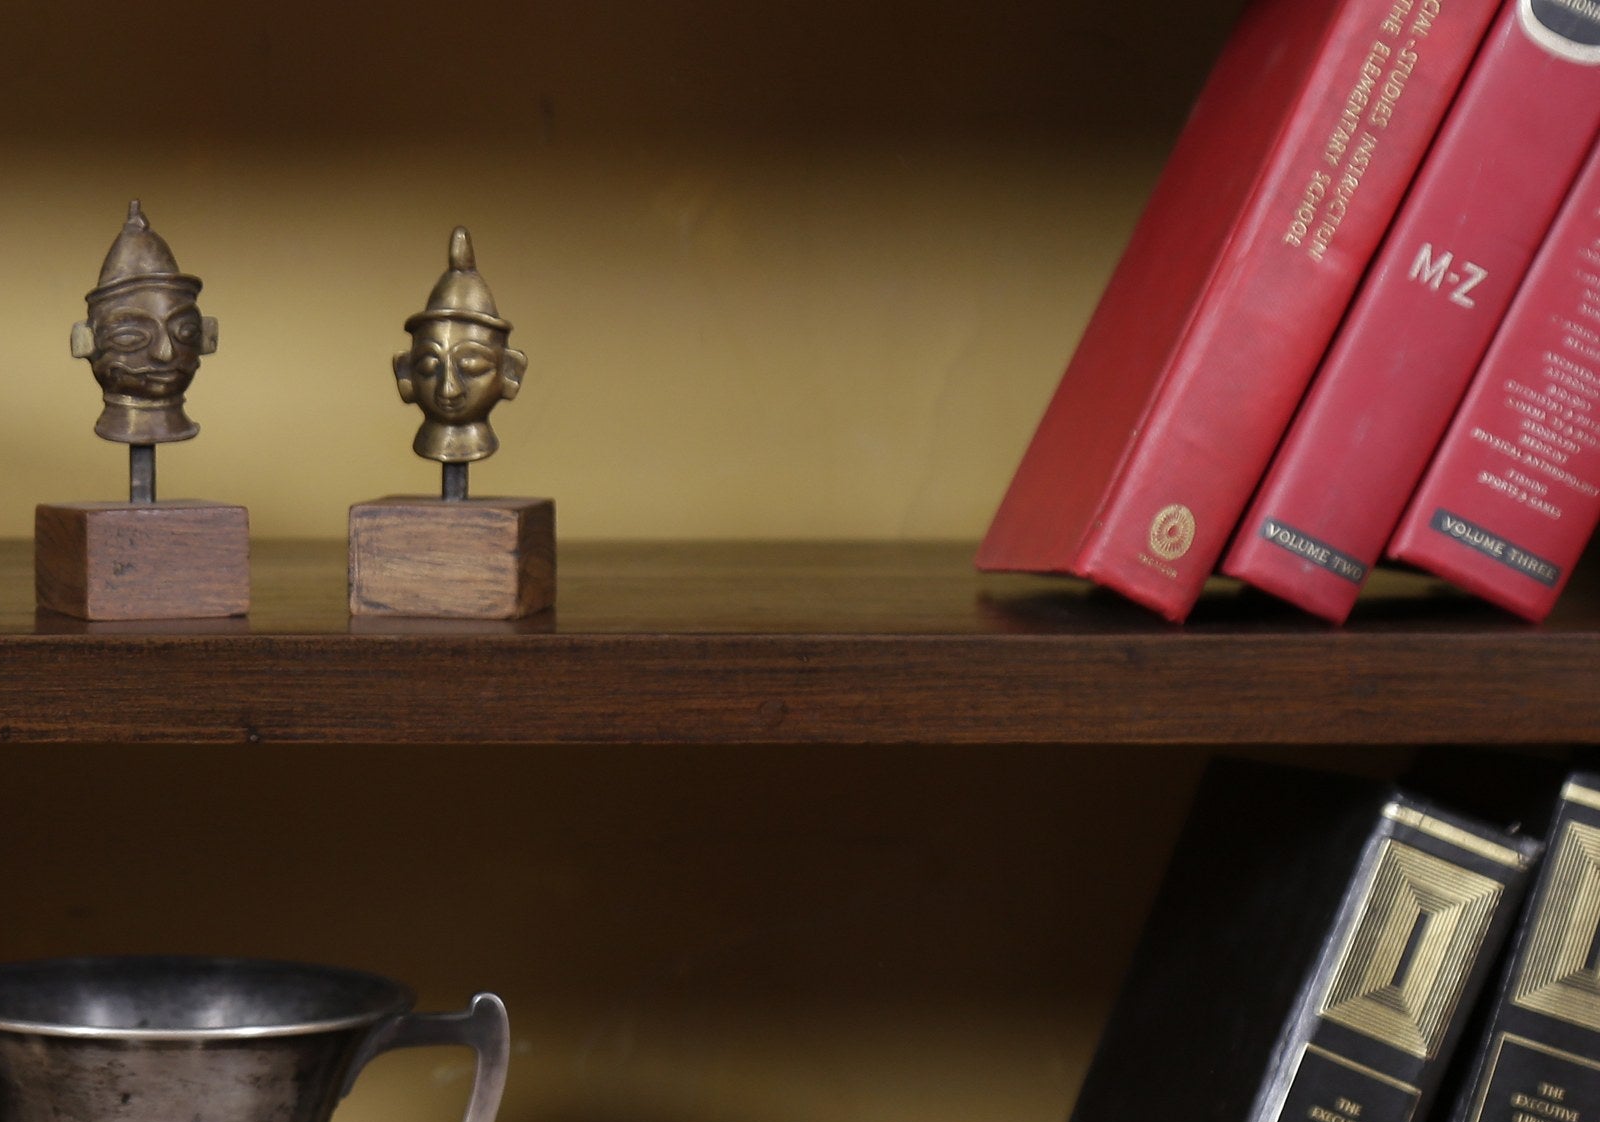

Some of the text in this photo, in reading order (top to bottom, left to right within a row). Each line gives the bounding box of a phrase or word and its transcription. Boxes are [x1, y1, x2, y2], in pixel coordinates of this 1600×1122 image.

[1325, 40, 1391, 167] ELEMENTARY
[1369, 48, 1418, 129] STUDIES
[1309, 132, 1378, 263] INSTRUCTION
[1408, 242, 1488, 309] M-Z
[1473, 428, 1521, 458] PHYSICAL
[1521, 434, 1568, 464] MEDICINE
[1480, 471, 1519, 497] SPORTS
[1529, 497, 1561, 519] GAMES
[1507, 469, 1548, 495] FISHING
[1267, 522, 1363, 581] VOLUME TWO
[1443, 515, 1558, 581] VOLUME THREE
[1336, 1097, 1362, 1116] THE
[1539, 1082, 1565, 1101] THE
